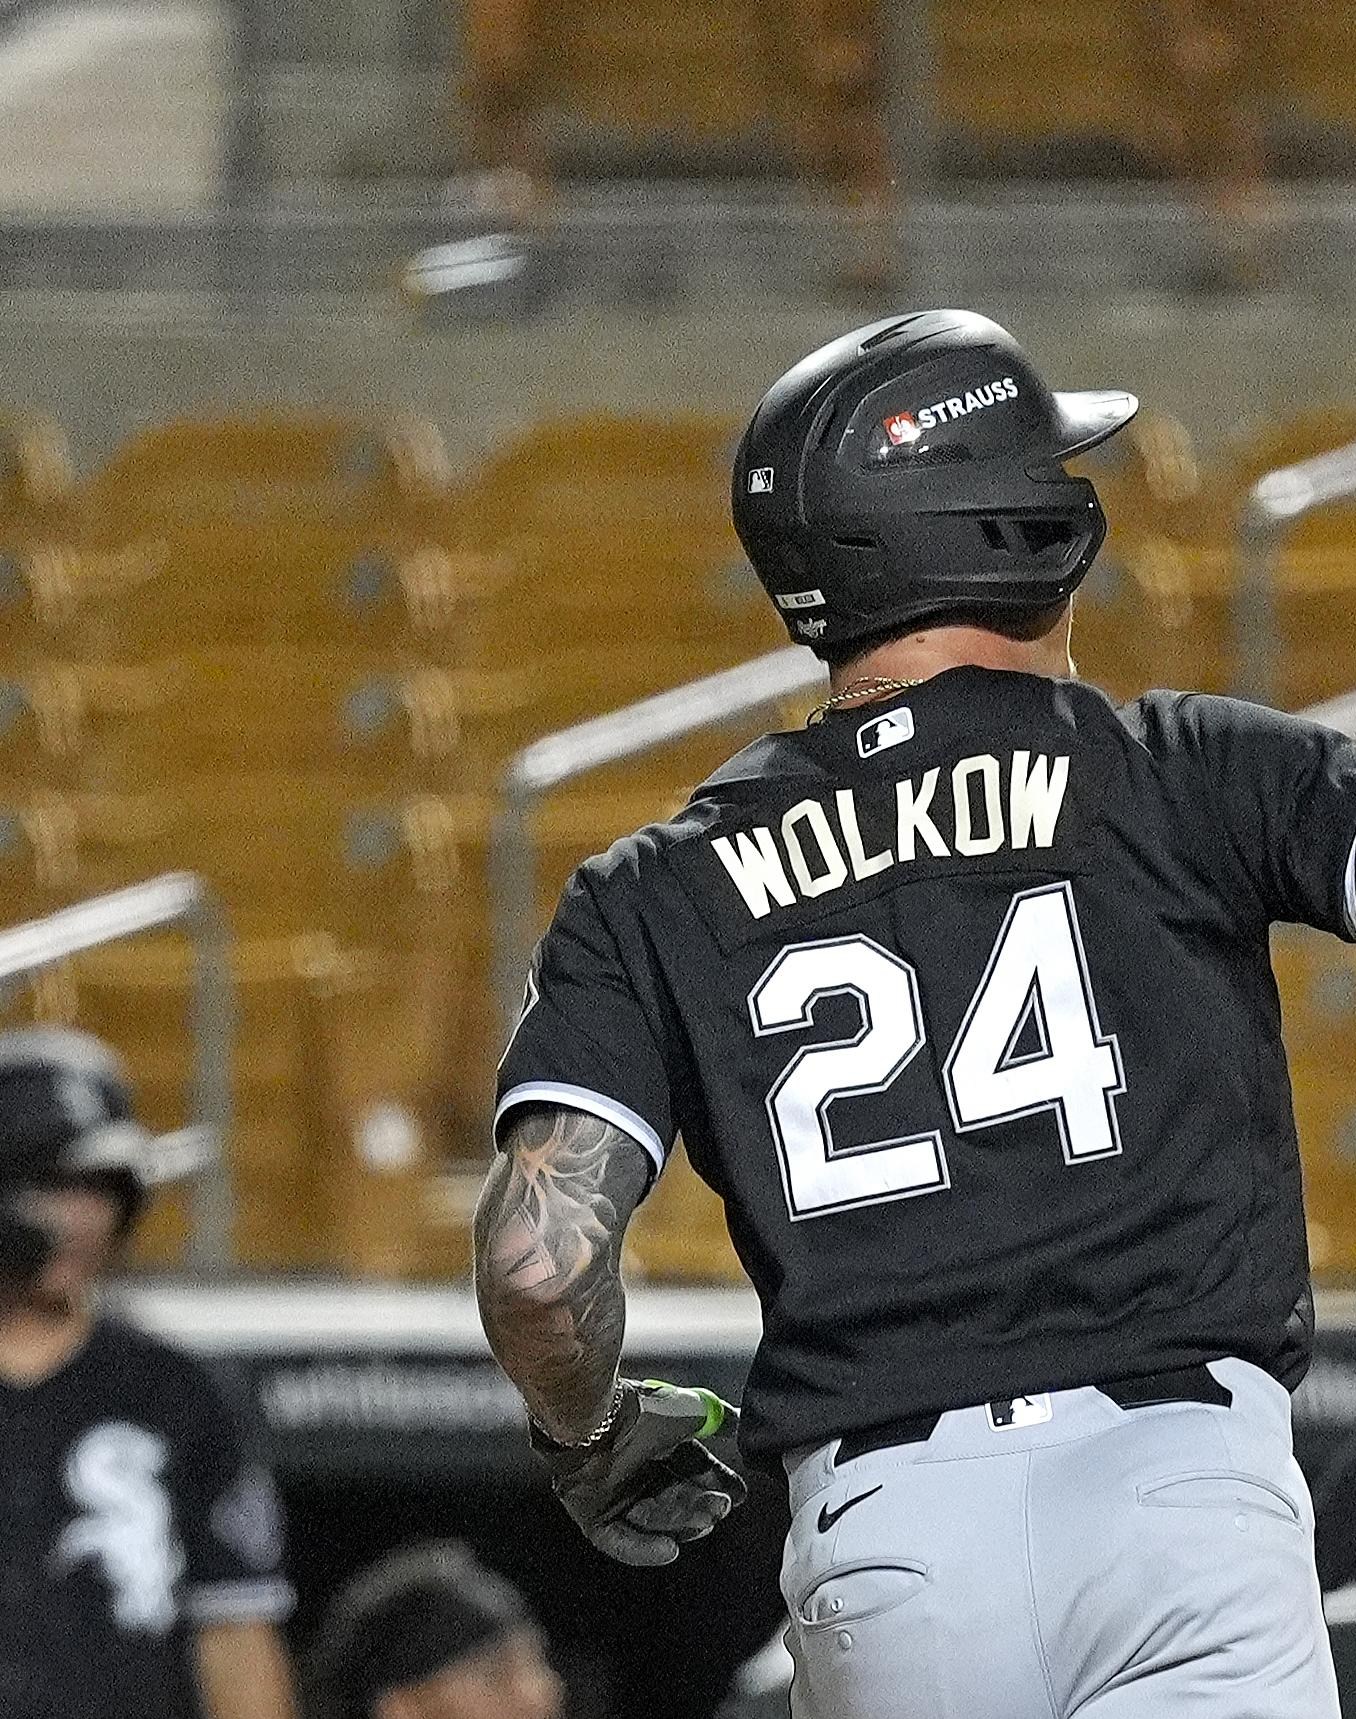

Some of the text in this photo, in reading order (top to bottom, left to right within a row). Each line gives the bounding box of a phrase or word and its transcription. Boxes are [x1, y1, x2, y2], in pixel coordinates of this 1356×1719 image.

[918, 377, 1019, 429] STRAUSS
[711, 750, 1070, 919] WOLKOW
[746, 880, 1128, 1222] 24
